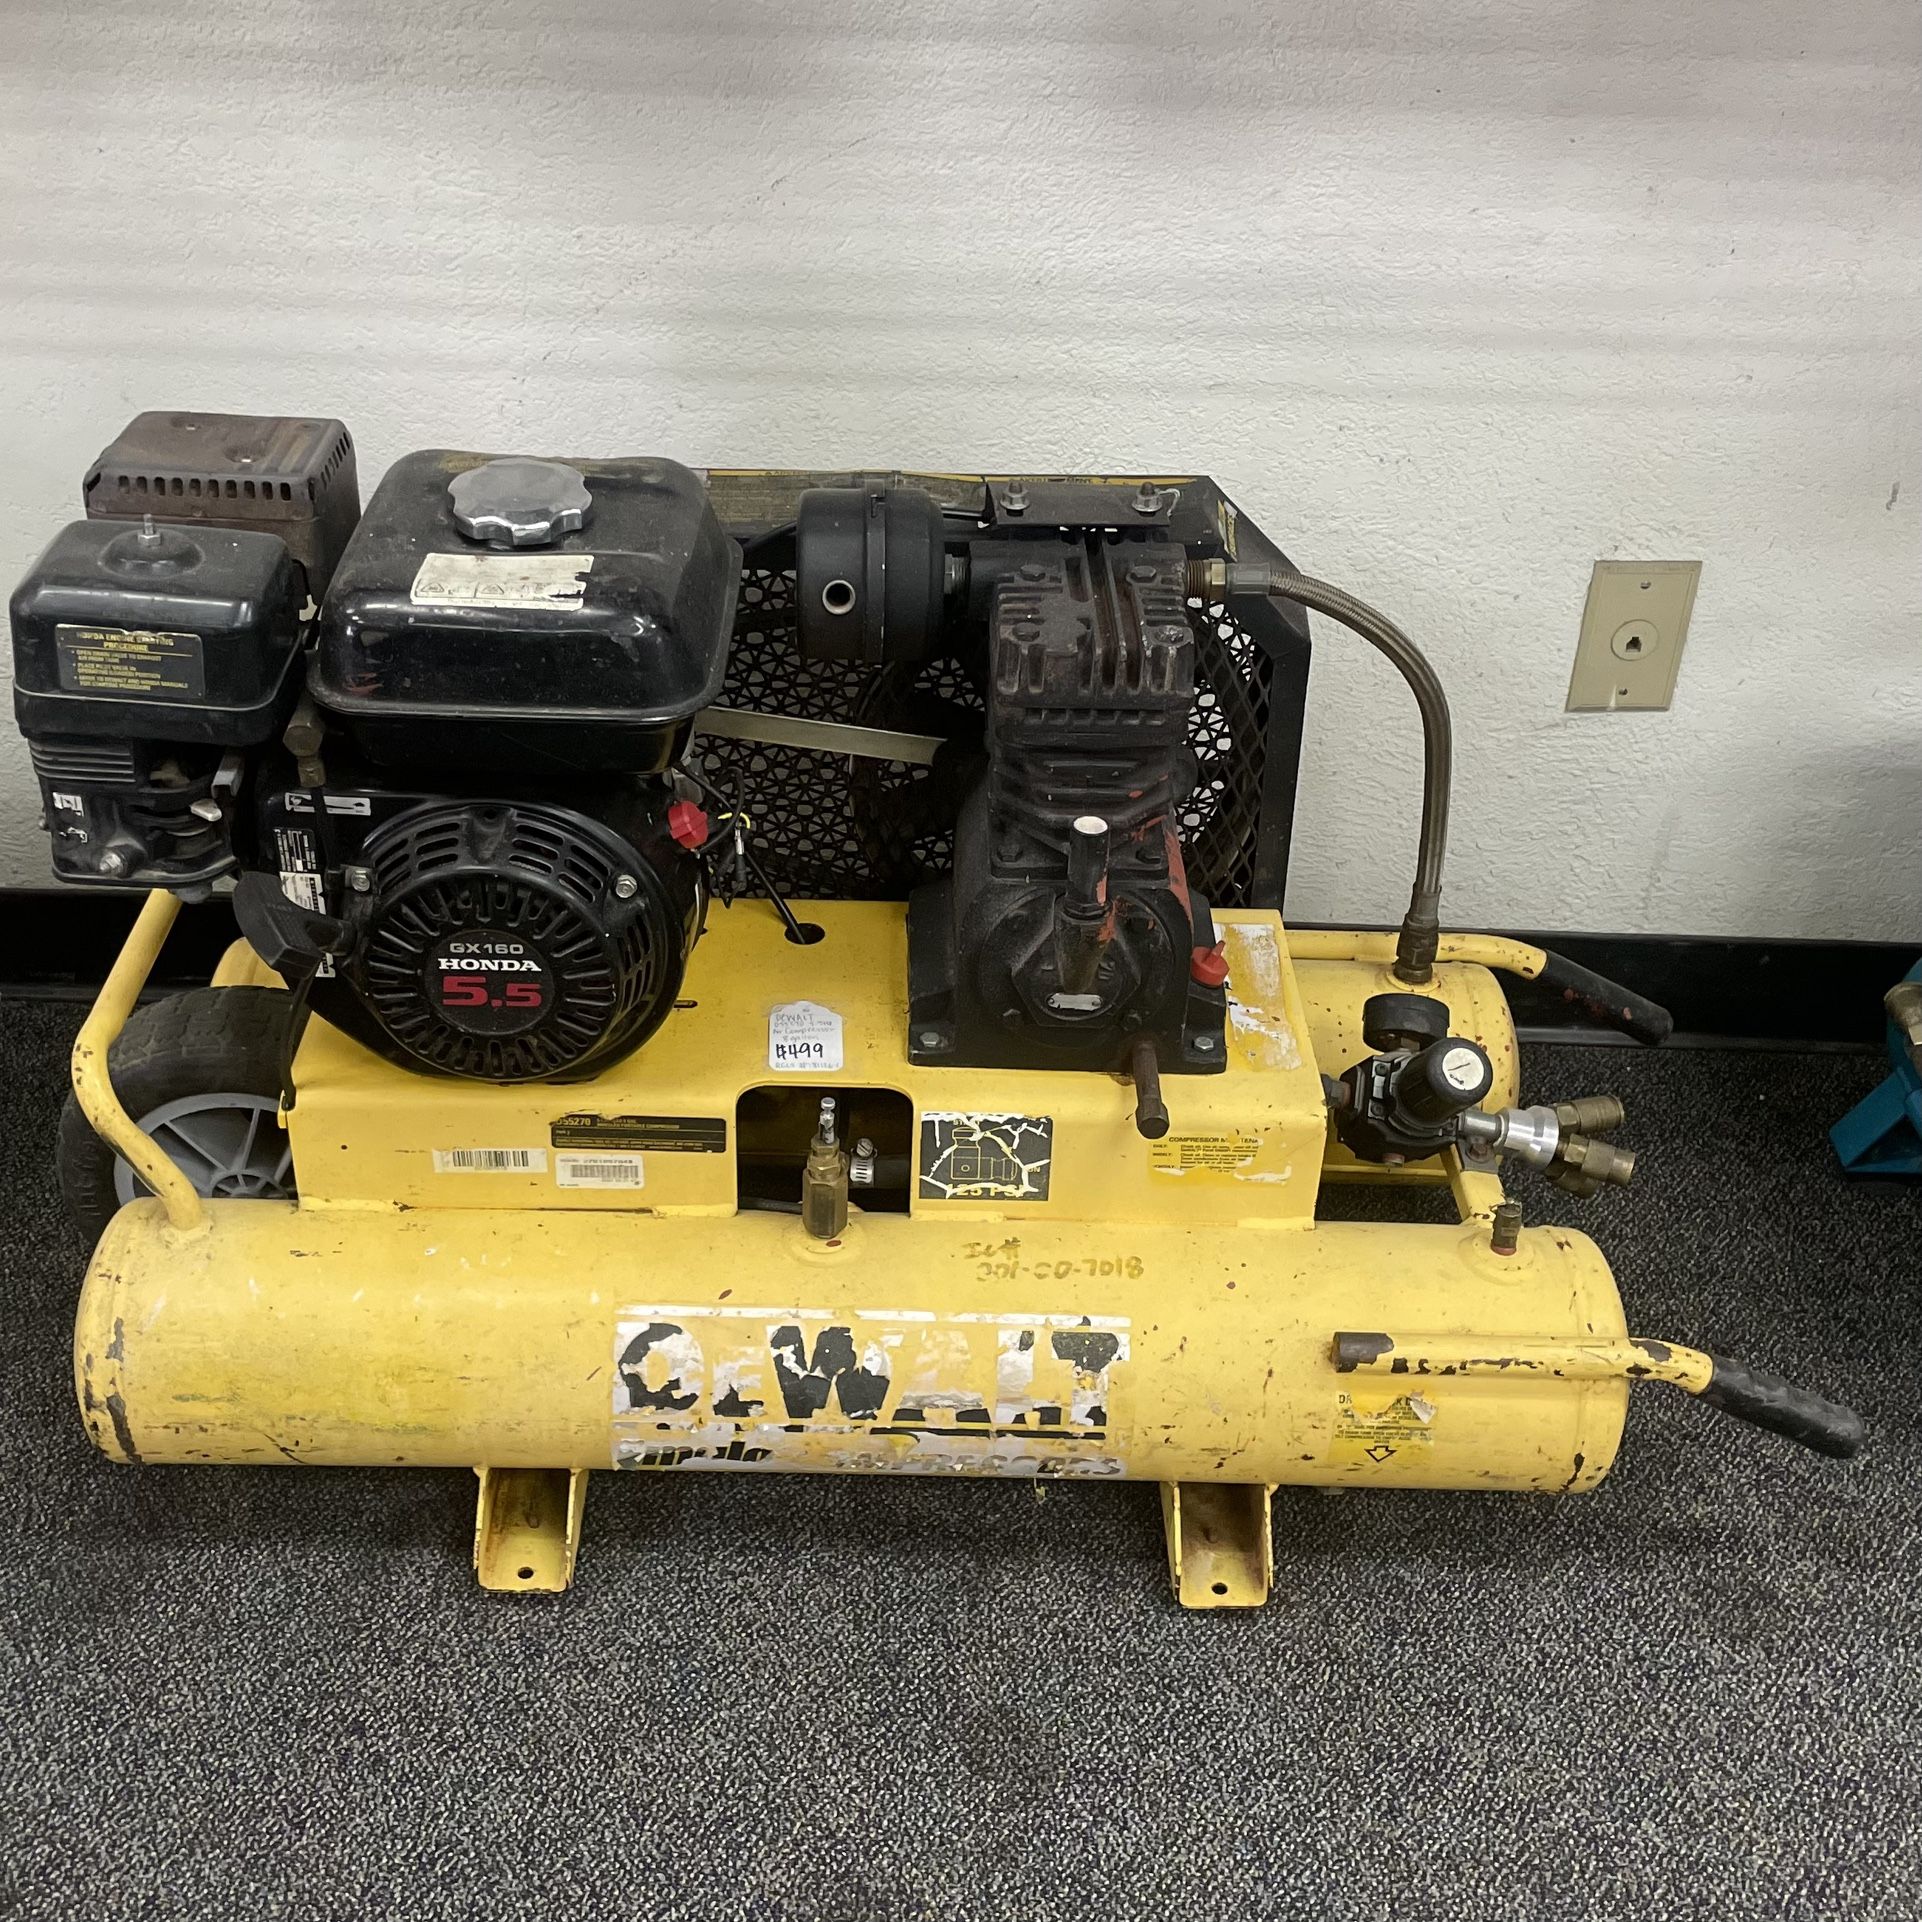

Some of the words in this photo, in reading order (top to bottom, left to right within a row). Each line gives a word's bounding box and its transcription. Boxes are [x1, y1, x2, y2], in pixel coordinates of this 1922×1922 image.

[449, 942, 524, 955] GX160
[437, 958, 542, 972] HONDA
[443, 976, 542, 1008] 5.5
[1168, 1136, 1219, 1144] COMPRESSOR
